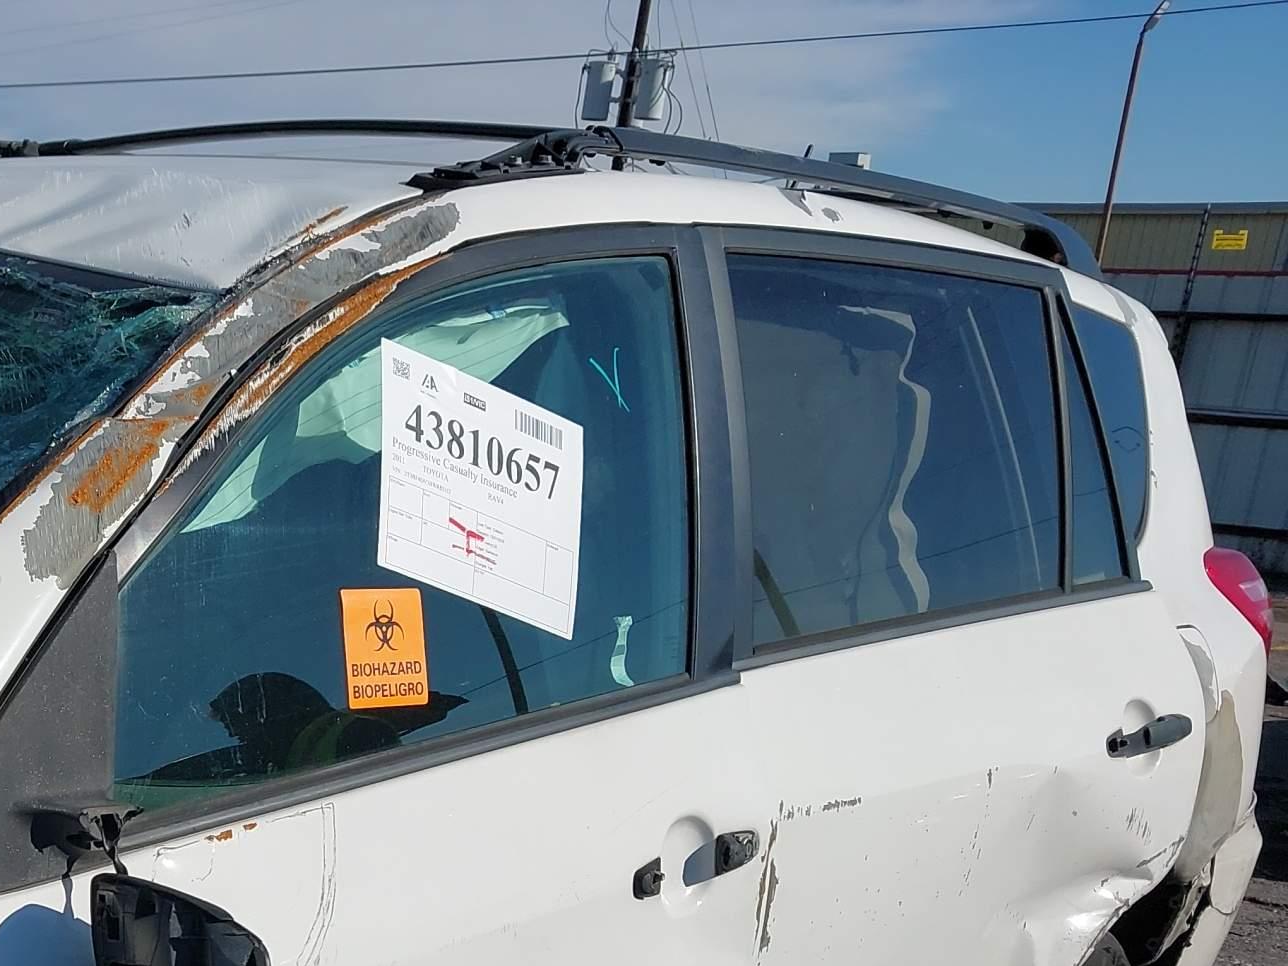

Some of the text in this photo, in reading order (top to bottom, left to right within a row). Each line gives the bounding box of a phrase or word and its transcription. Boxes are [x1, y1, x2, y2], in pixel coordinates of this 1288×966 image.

[392, 437, 441, 466] Progressive
[443, 458, 478, 484] Casualty
[480, 473, 518, 498] Insurance
[404, 404, 560, 500] 43810657
[423, 466, 449, 482] TOYOTA
[487, 493, 504, 505] RAV4
[352, 661, 422, 677] BIOHAZARD
[353, 682, 424, 699] BIOPELIGRO
